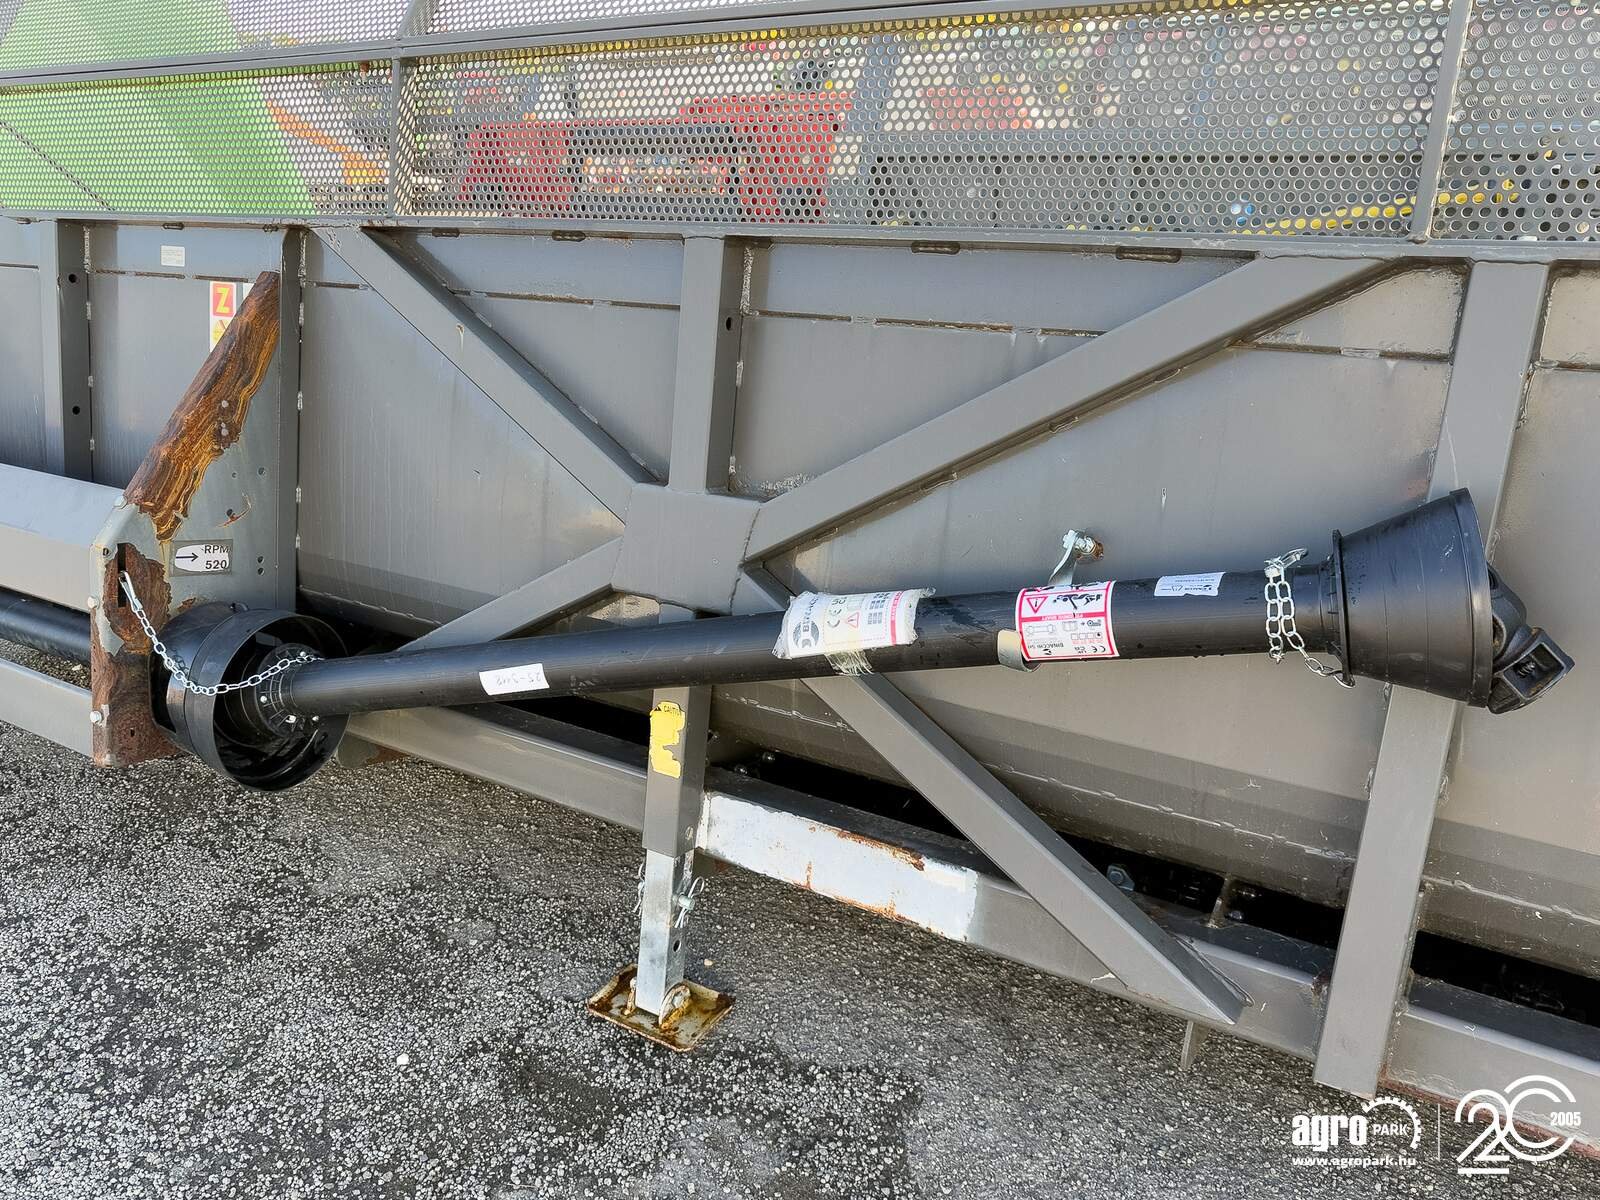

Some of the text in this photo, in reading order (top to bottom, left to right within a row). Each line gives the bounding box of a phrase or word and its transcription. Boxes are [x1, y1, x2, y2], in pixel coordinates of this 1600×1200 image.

[215, 287, 230, 314] Z
[204, 544, 229, 554] RPM
[205, 559, 227, 570] 520
